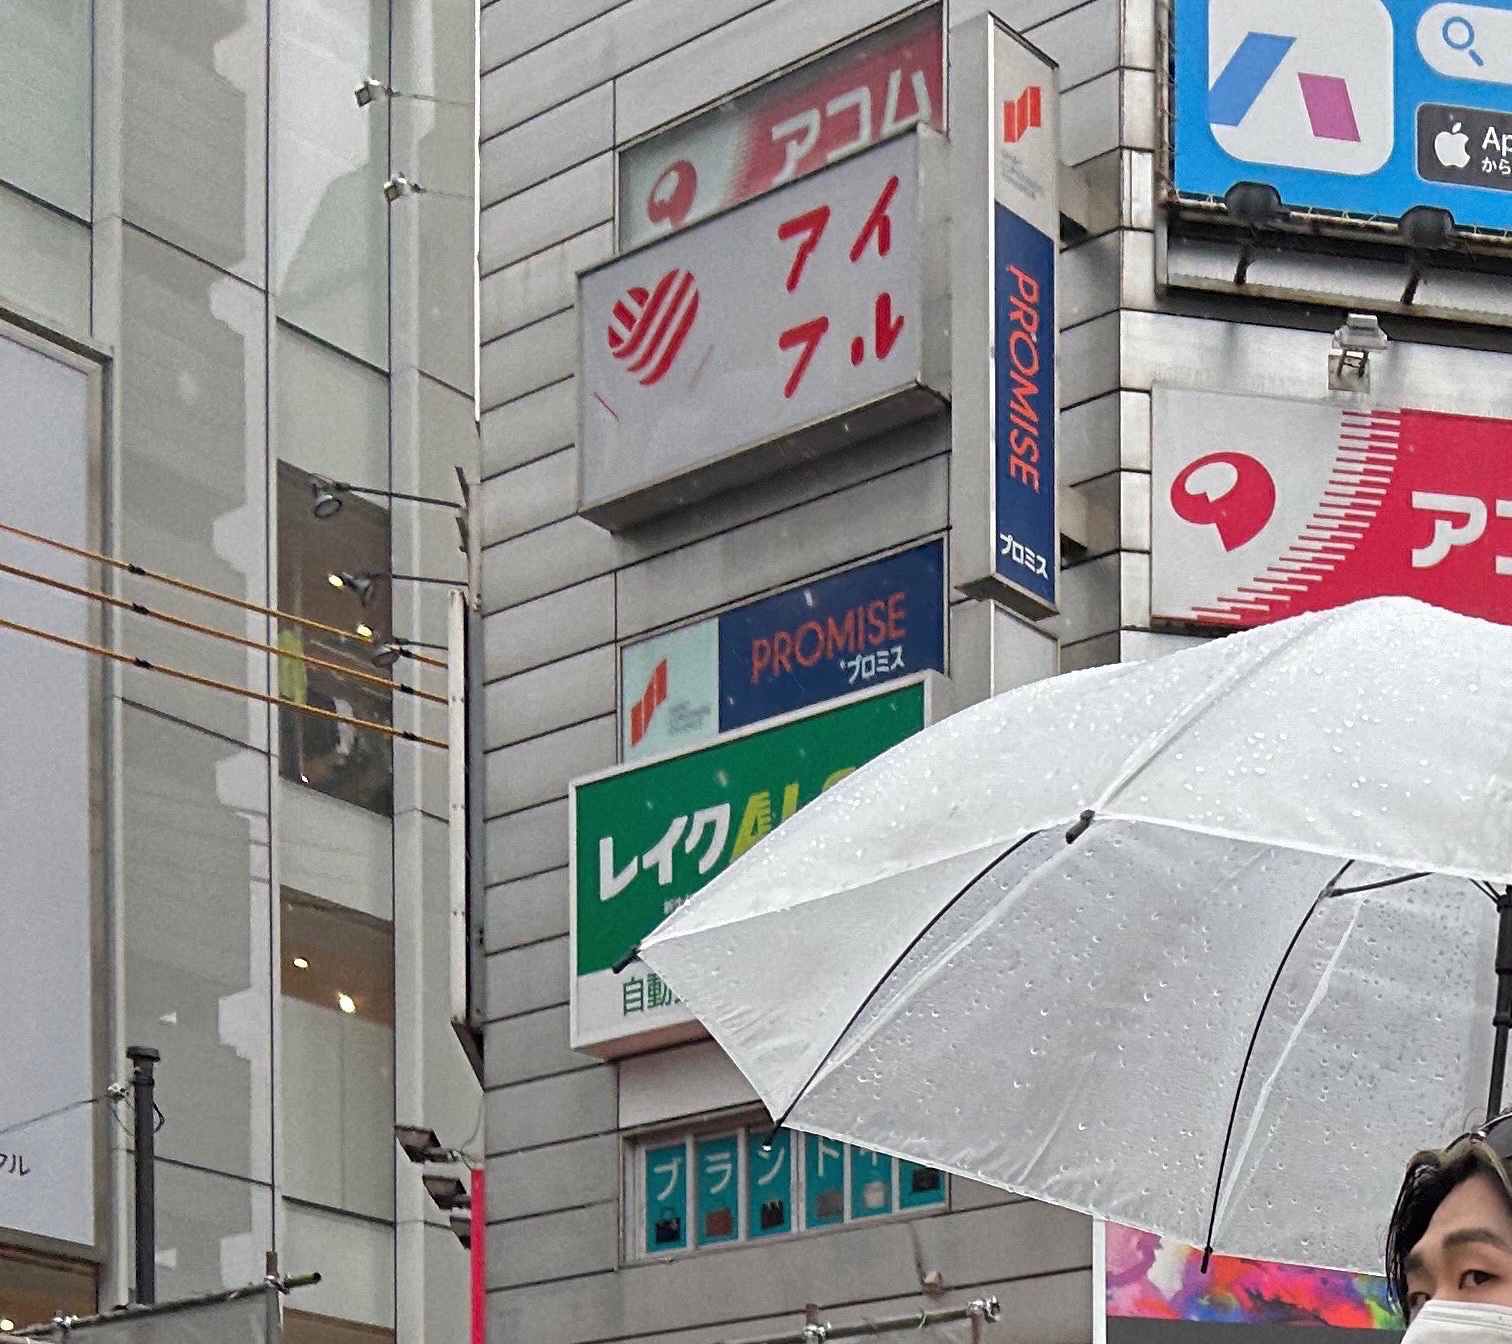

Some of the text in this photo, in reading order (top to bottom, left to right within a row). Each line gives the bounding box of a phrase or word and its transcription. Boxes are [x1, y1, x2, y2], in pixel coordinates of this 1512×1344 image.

[771, 68, 932, 186] アコム
[778, 175, 899, 291] アイ
[779, 292, 904, 399] フル
[1006, 264, 1040, 494] PROMISE
[1000, 533, 1048, 580] プロミス
[751, 592, 906, 685] PROMISE
[846, 645, 906, 685] プロミス
